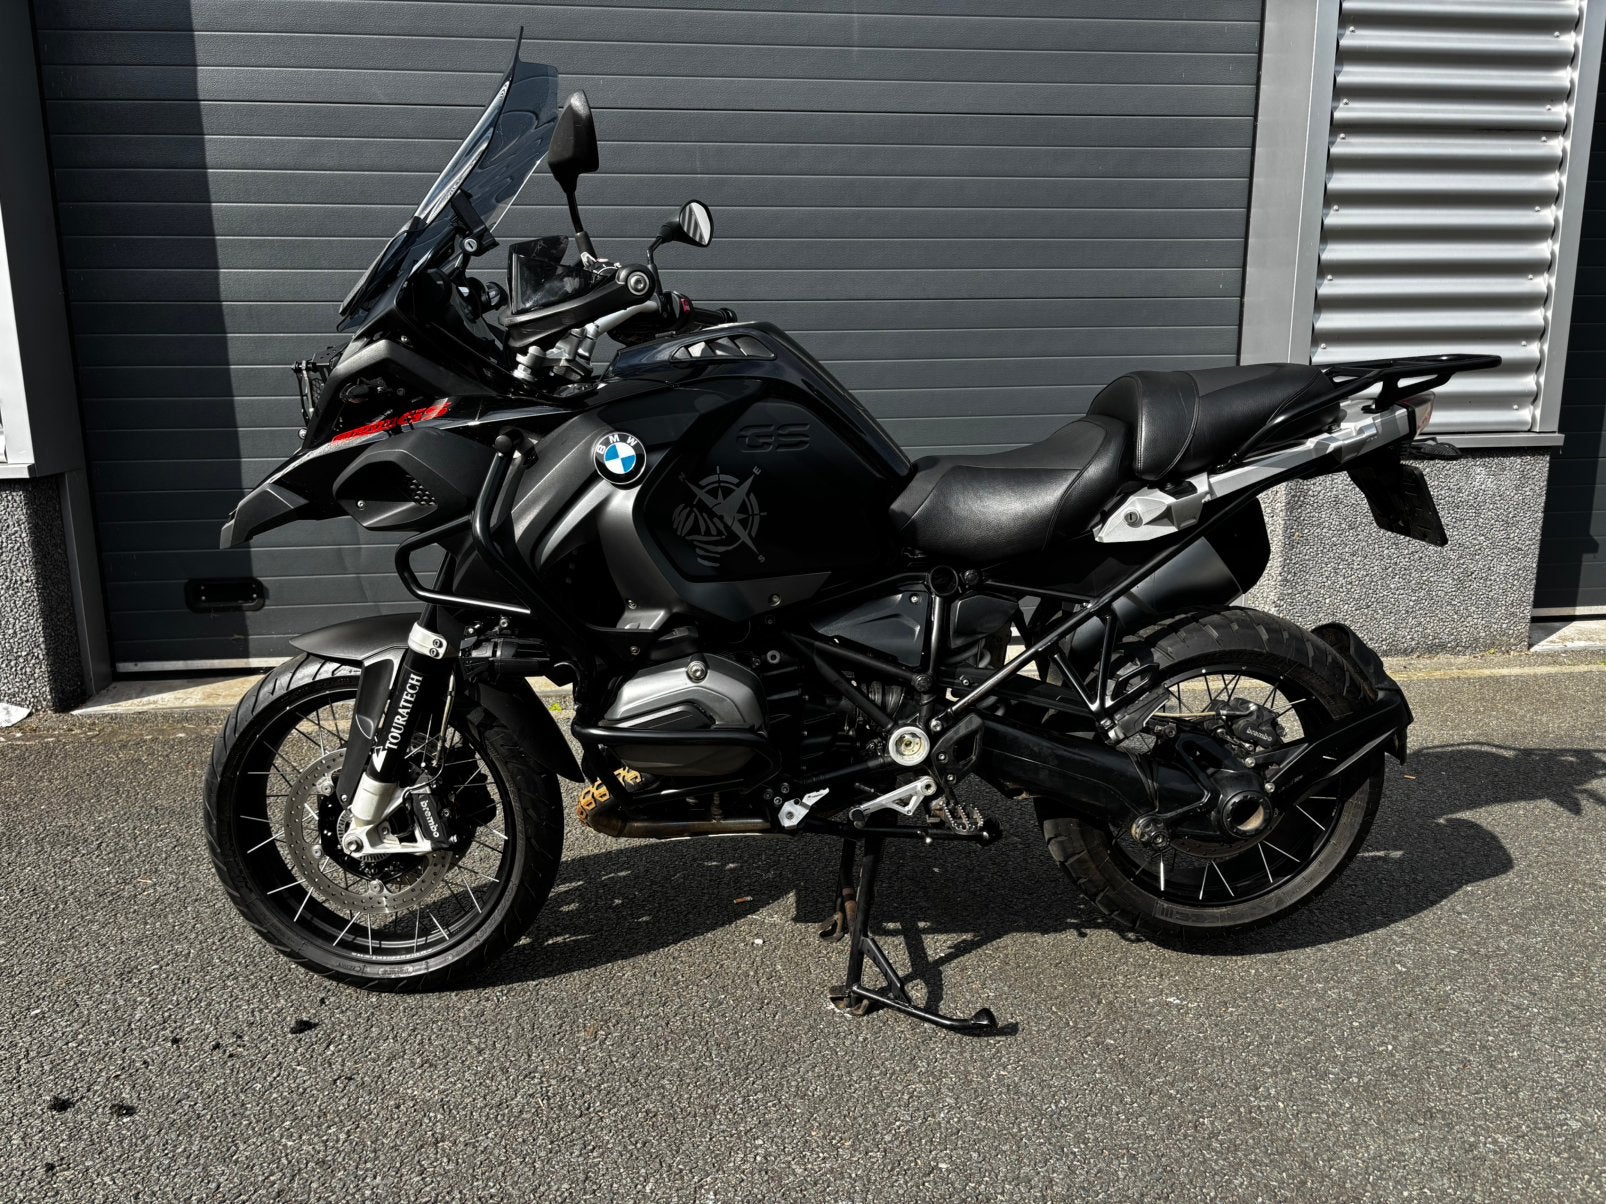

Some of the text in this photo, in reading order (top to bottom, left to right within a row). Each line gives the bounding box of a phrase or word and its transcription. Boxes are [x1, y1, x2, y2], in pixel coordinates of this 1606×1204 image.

[597, 434, 637, 454] BMW
[736, 423, 810, 453] GS
[385, 673, 423, 750] TOURATECH
[1246, 727, 1272, 741] brembo
[420, 799, 440, 838] brembo
